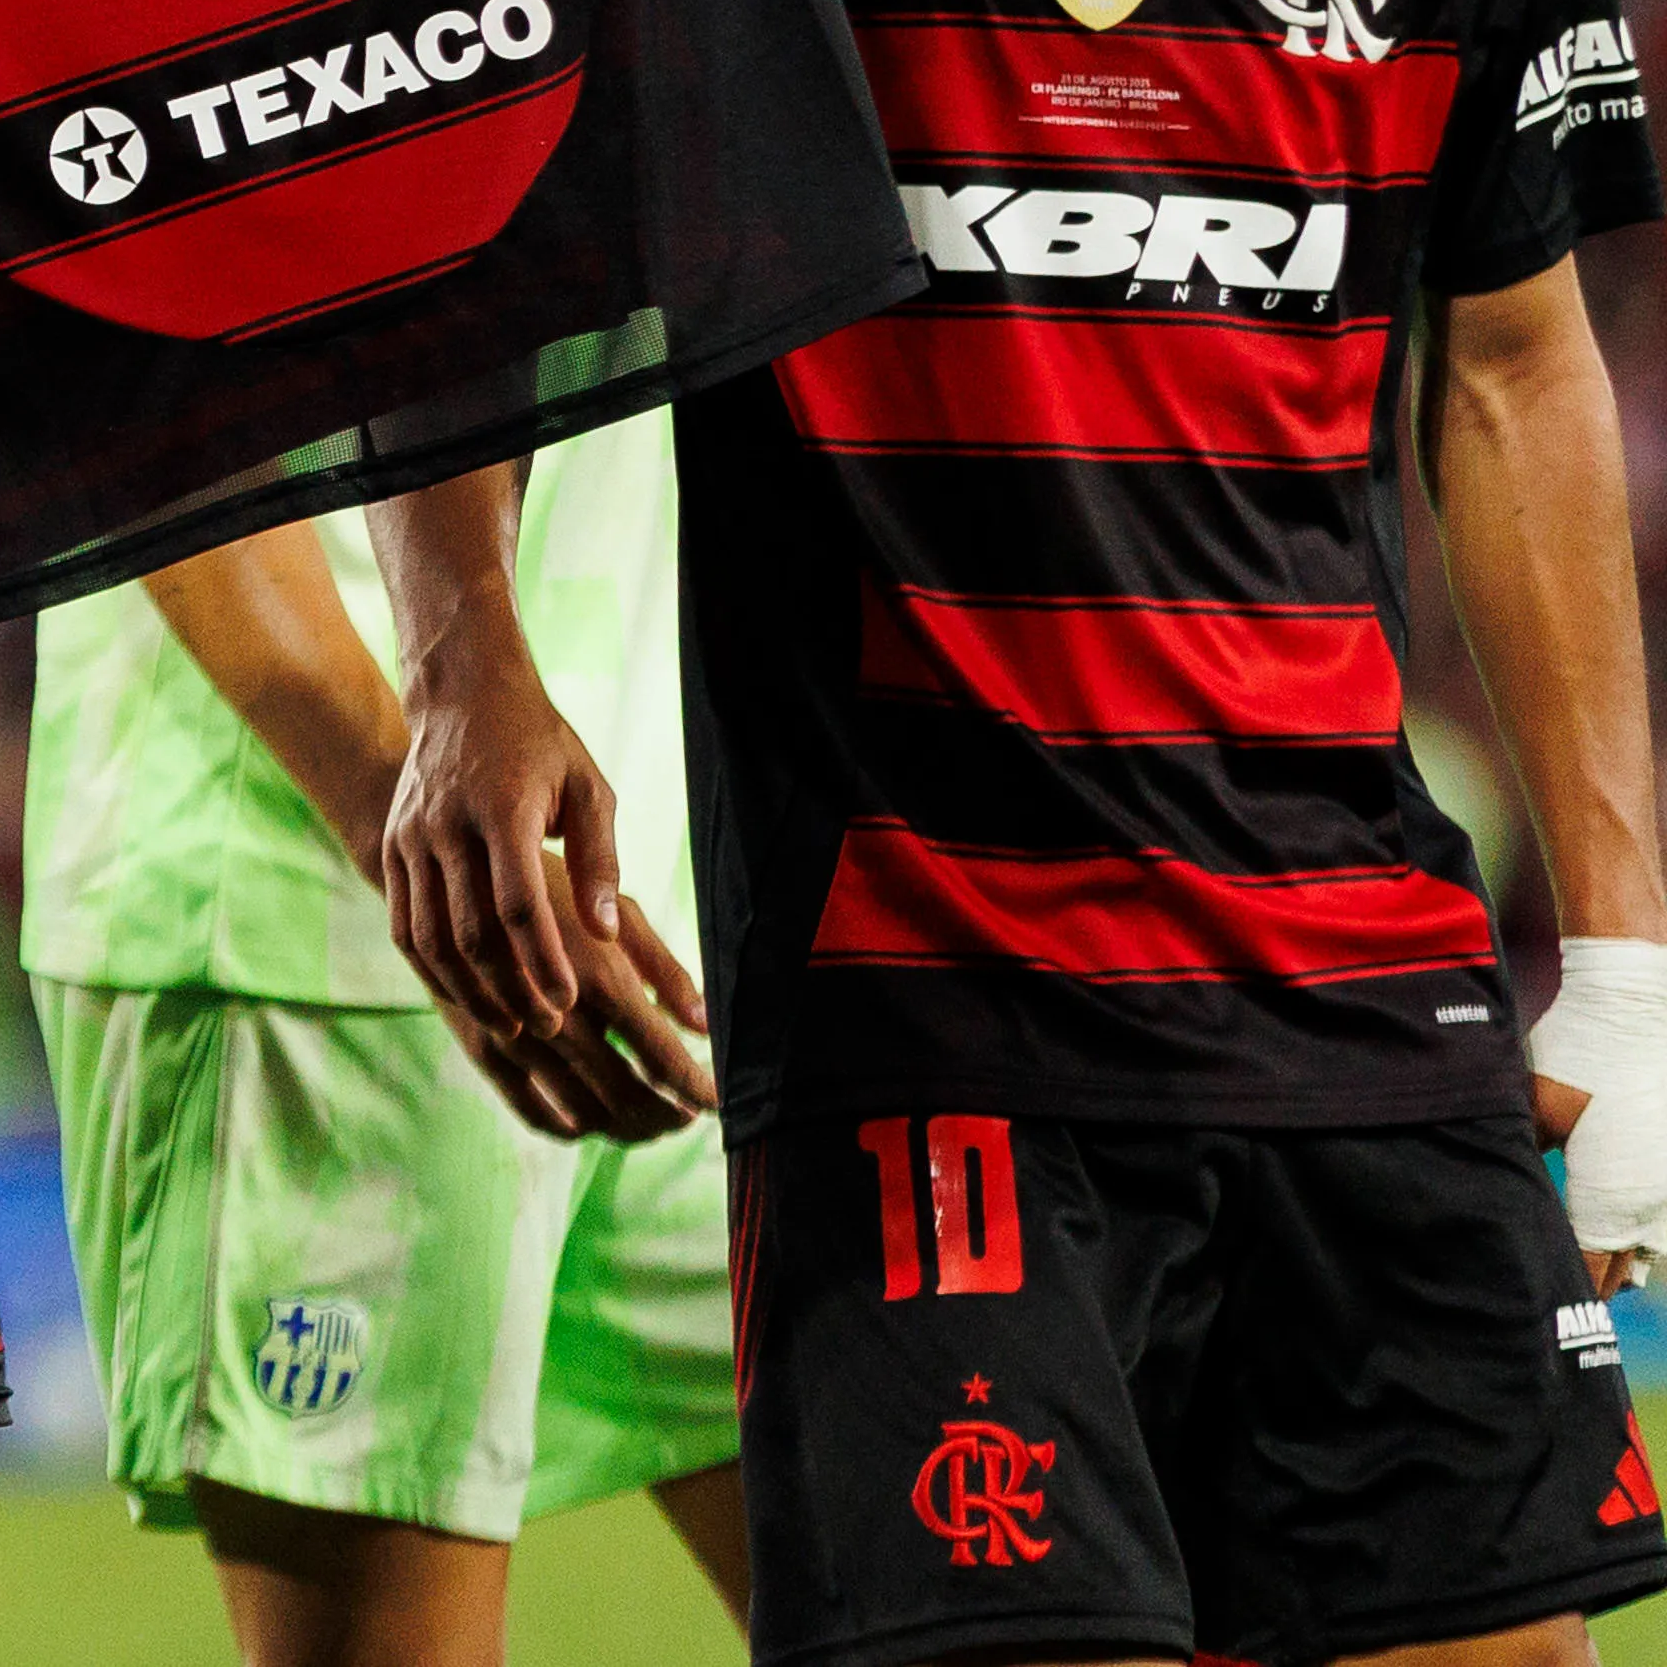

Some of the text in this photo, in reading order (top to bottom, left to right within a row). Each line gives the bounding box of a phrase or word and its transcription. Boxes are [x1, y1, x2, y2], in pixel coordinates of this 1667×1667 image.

[1045, 83, 1100, 97] FLAMENGO
[1122, 89, 1180, 101] BARCELONA
[898, 185, 1347, 291] XBRI
[1126, 281, 1331, 313] PNEUS
[858, 1114, 1024, 1301] 10
